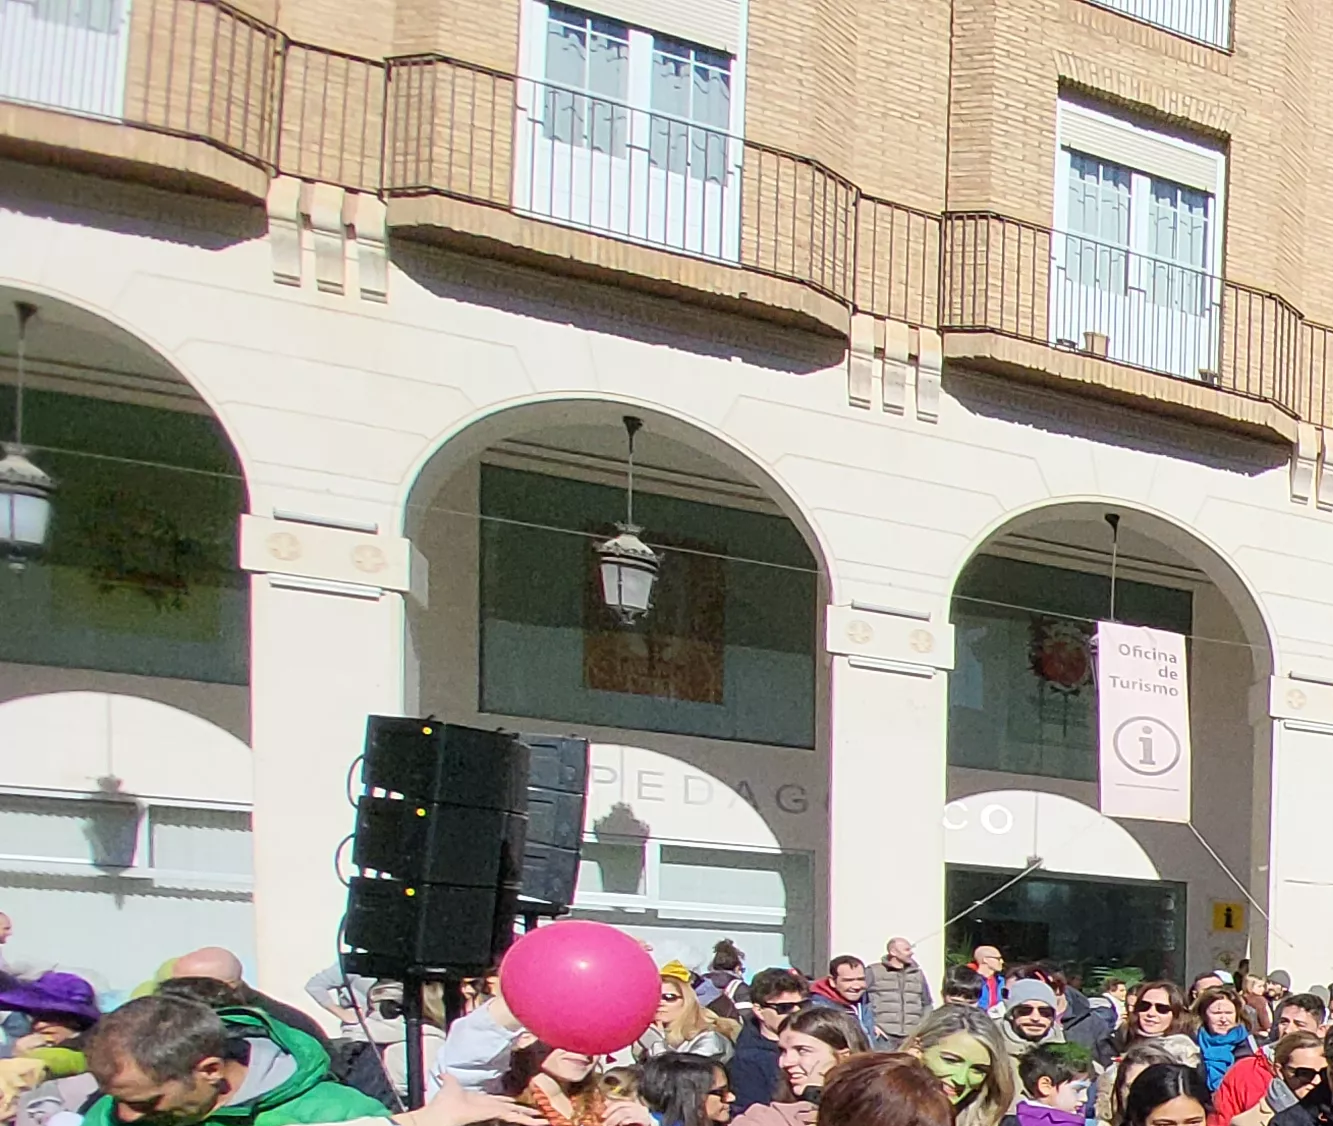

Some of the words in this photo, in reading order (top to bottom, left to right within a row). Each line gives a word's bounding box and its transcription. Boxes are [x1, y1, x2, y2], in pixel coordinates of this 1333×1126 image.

[1118, 643, 1178, 664] Oficina
[1157, 665, 1179, 680] de
[1108, 675, 1179, 697] Turismo
[591, 764, 830, 816] PEDAG
